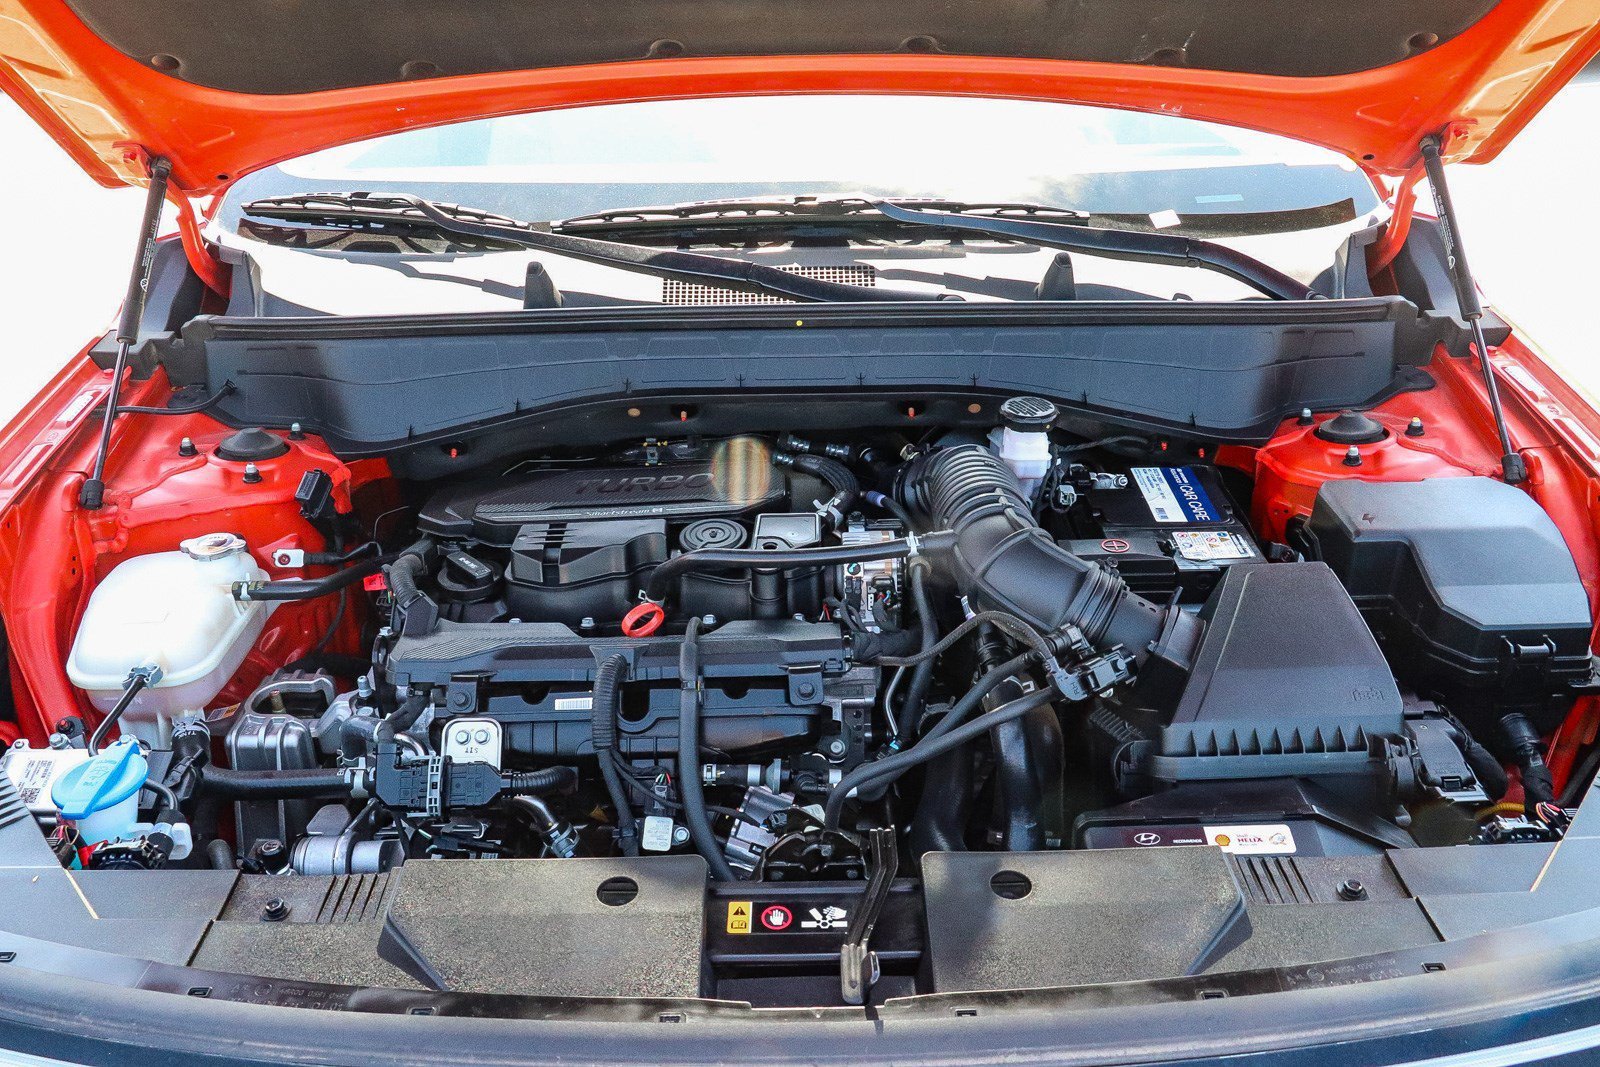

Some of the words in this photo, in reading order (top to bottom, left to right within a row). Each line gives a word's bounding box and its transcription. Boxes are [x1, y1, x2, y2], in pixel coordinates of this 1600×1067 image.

[575, 473, 714, 494] TURBO
[1180, 485, 1198, 500] CAR
[586, 508, 650, 516] Smartstream
[1188, 501, 1211, 521] CARE
